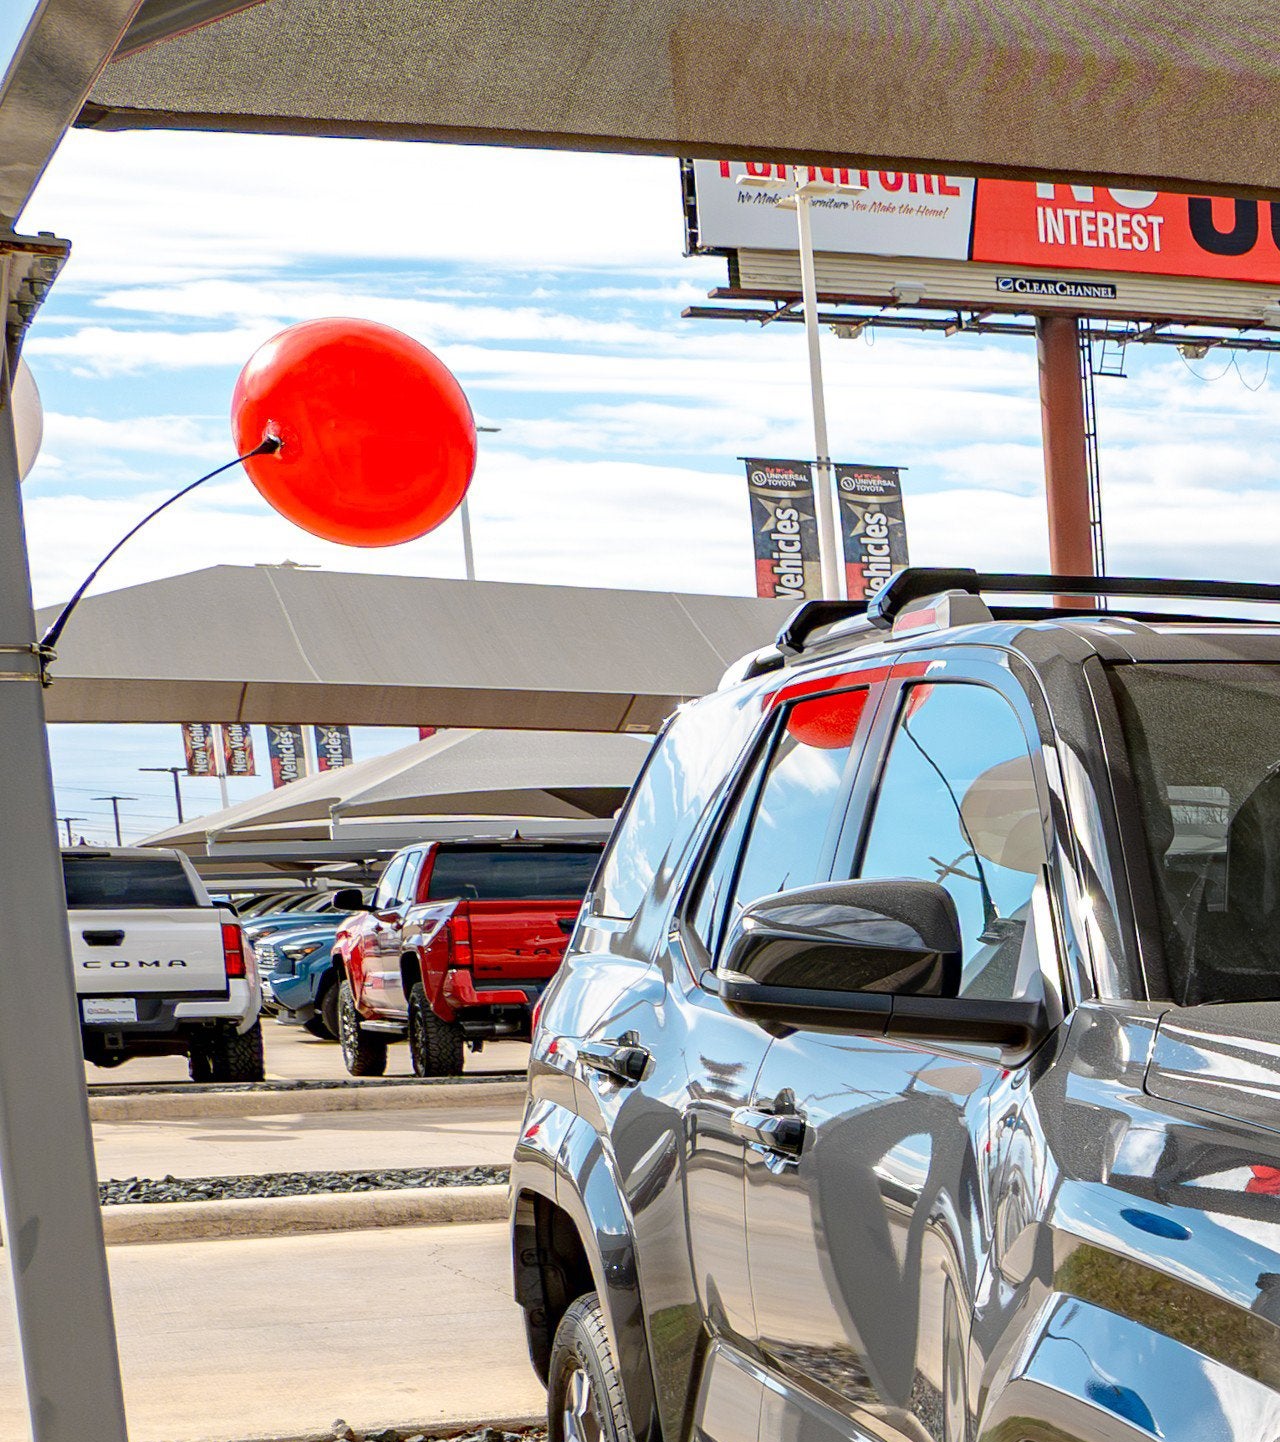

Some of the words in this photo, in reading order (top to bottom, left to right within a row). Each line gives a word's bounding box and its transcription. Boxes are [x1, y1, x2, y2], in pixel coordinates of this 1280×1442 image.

[811, 197, 849, 210] urniture
[851, 200, 867, 211] You
[869, 201, 896, 214] Make
[1036, 207, 1164, 253] INTEREST
[766, 474, 809, 482] UNIVERSAL
[768, 480, 797, 488] TOYOTA
[855, 479, 897, 488] UNIVERSAL
[857, 485, 885, 493] TOYOTA
[771, 507, 805, 600] Vehicles
[193, 750, 209, 772] New
[232, 750, 248, 772] New
[277, 731, 298, 781] Vehicles
[83, 960, 188, 969] COMA
